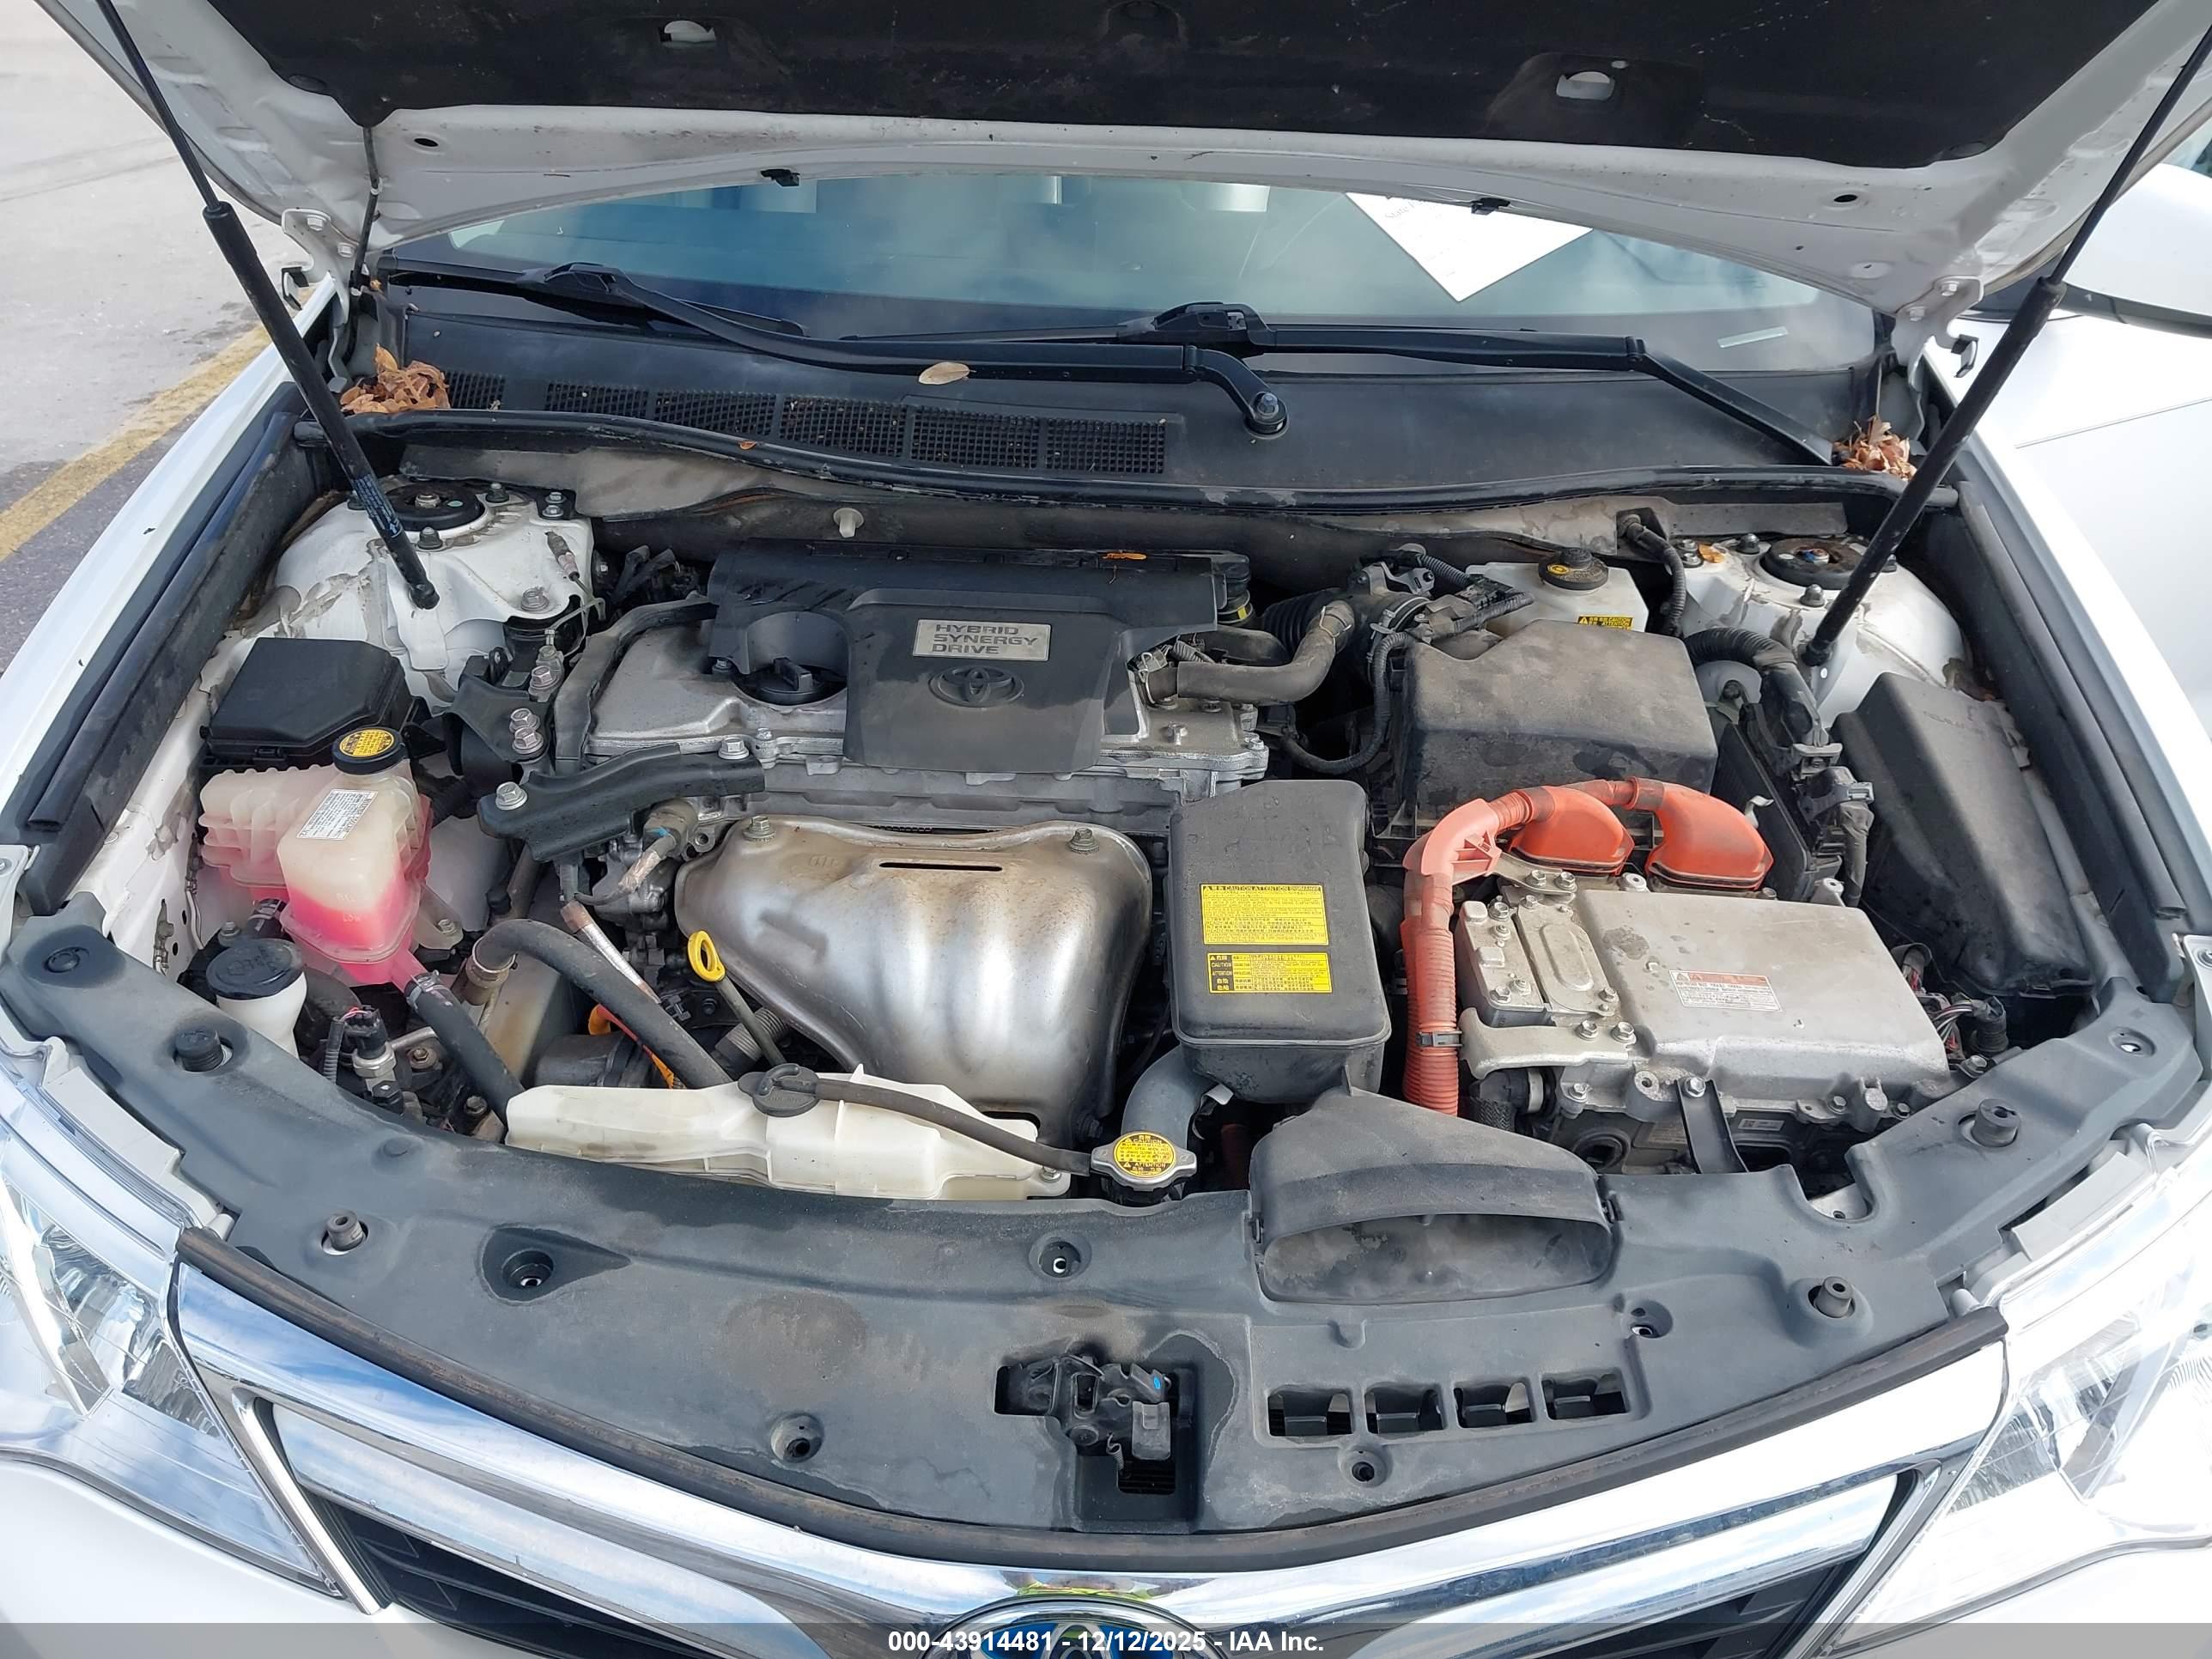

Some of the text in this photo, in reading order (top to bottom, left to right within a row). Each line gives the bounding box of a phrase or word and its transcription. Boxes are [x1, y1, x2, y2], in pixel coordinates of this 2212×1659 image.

[935, 624, 1018, 635] HYBRID
[933, 634, 1037, 645] SYNERGY
[932, 644, 1000, 654] DRIVE
